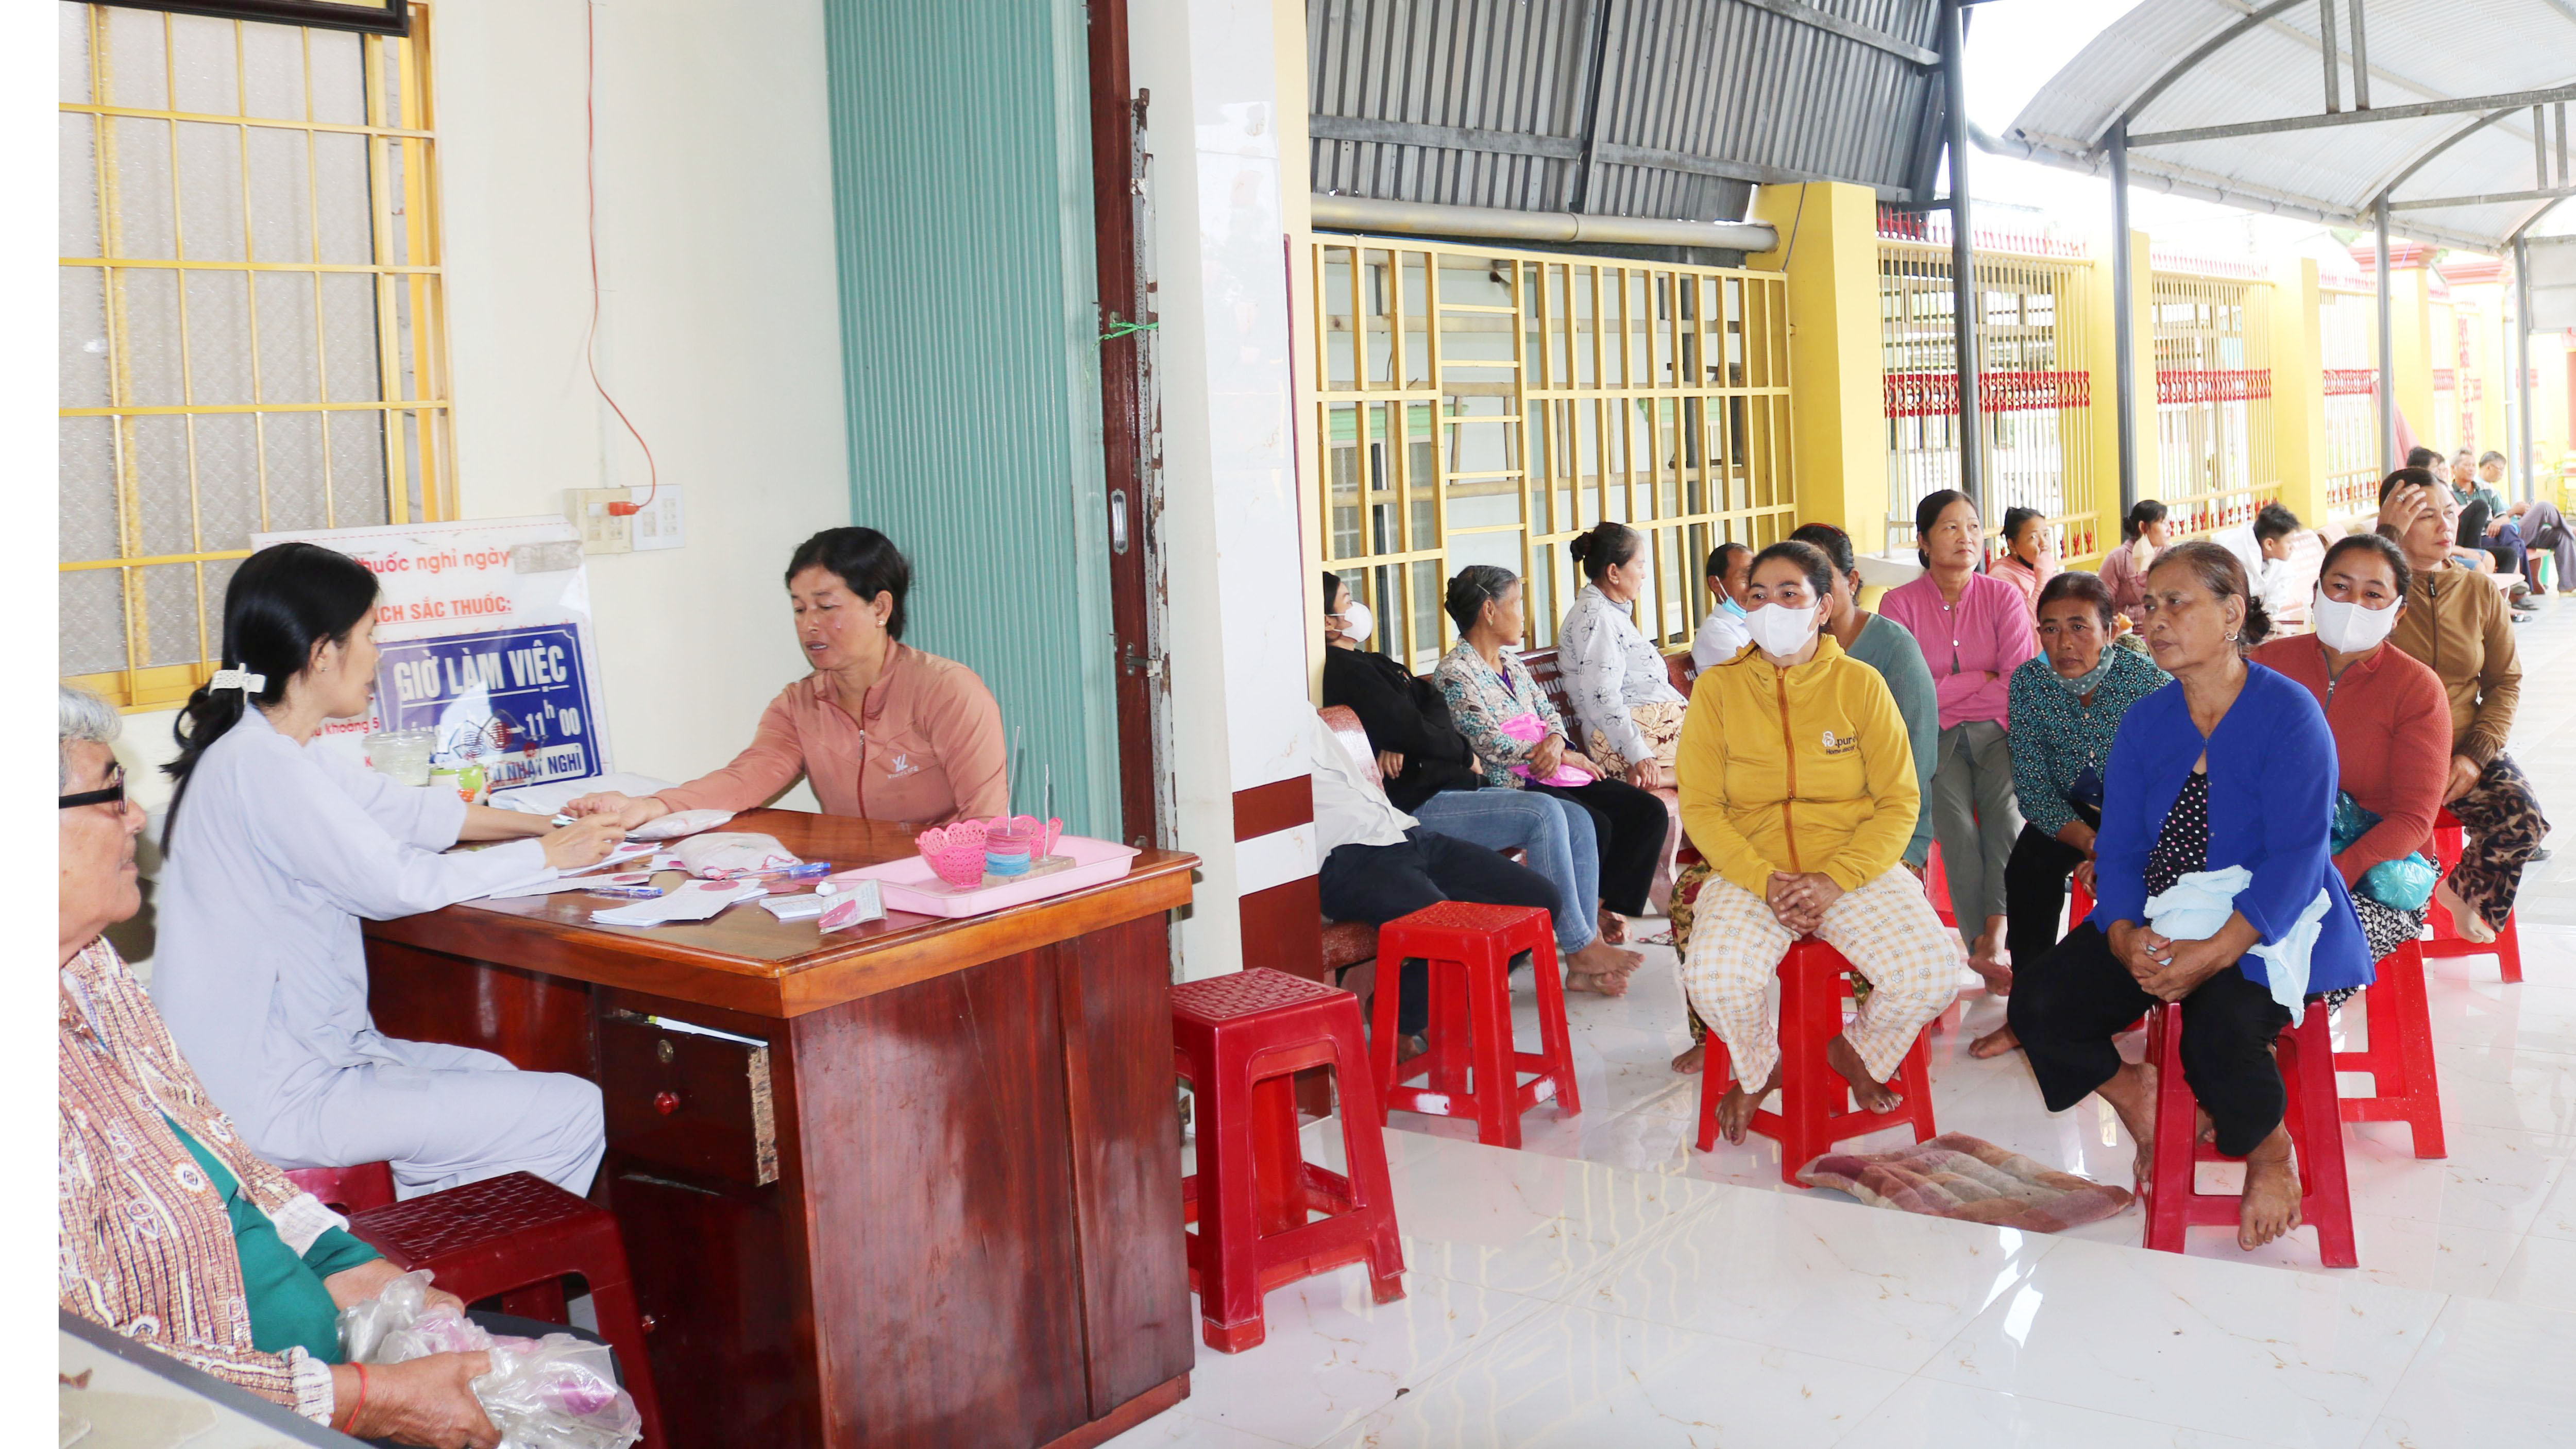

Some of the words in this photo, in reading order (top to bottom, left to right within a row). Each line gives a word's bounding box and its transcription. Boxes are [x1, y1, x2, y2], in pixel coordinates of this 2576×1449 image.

[416, 548, 457, 574] nghỉ
[464, 547, 510, 571] ngày
[410, 596, 446, 620] SẮC
[450, 591, 512, 616] THUỐC:
[393, 650, 441, 702] GIỜ
[445, 647, 505, 695] LÀM
[507, 639, 567, 692] VIỆC
[372, 717, 380, 729] 5
[547, 745, 582, 775] NGHỈ
